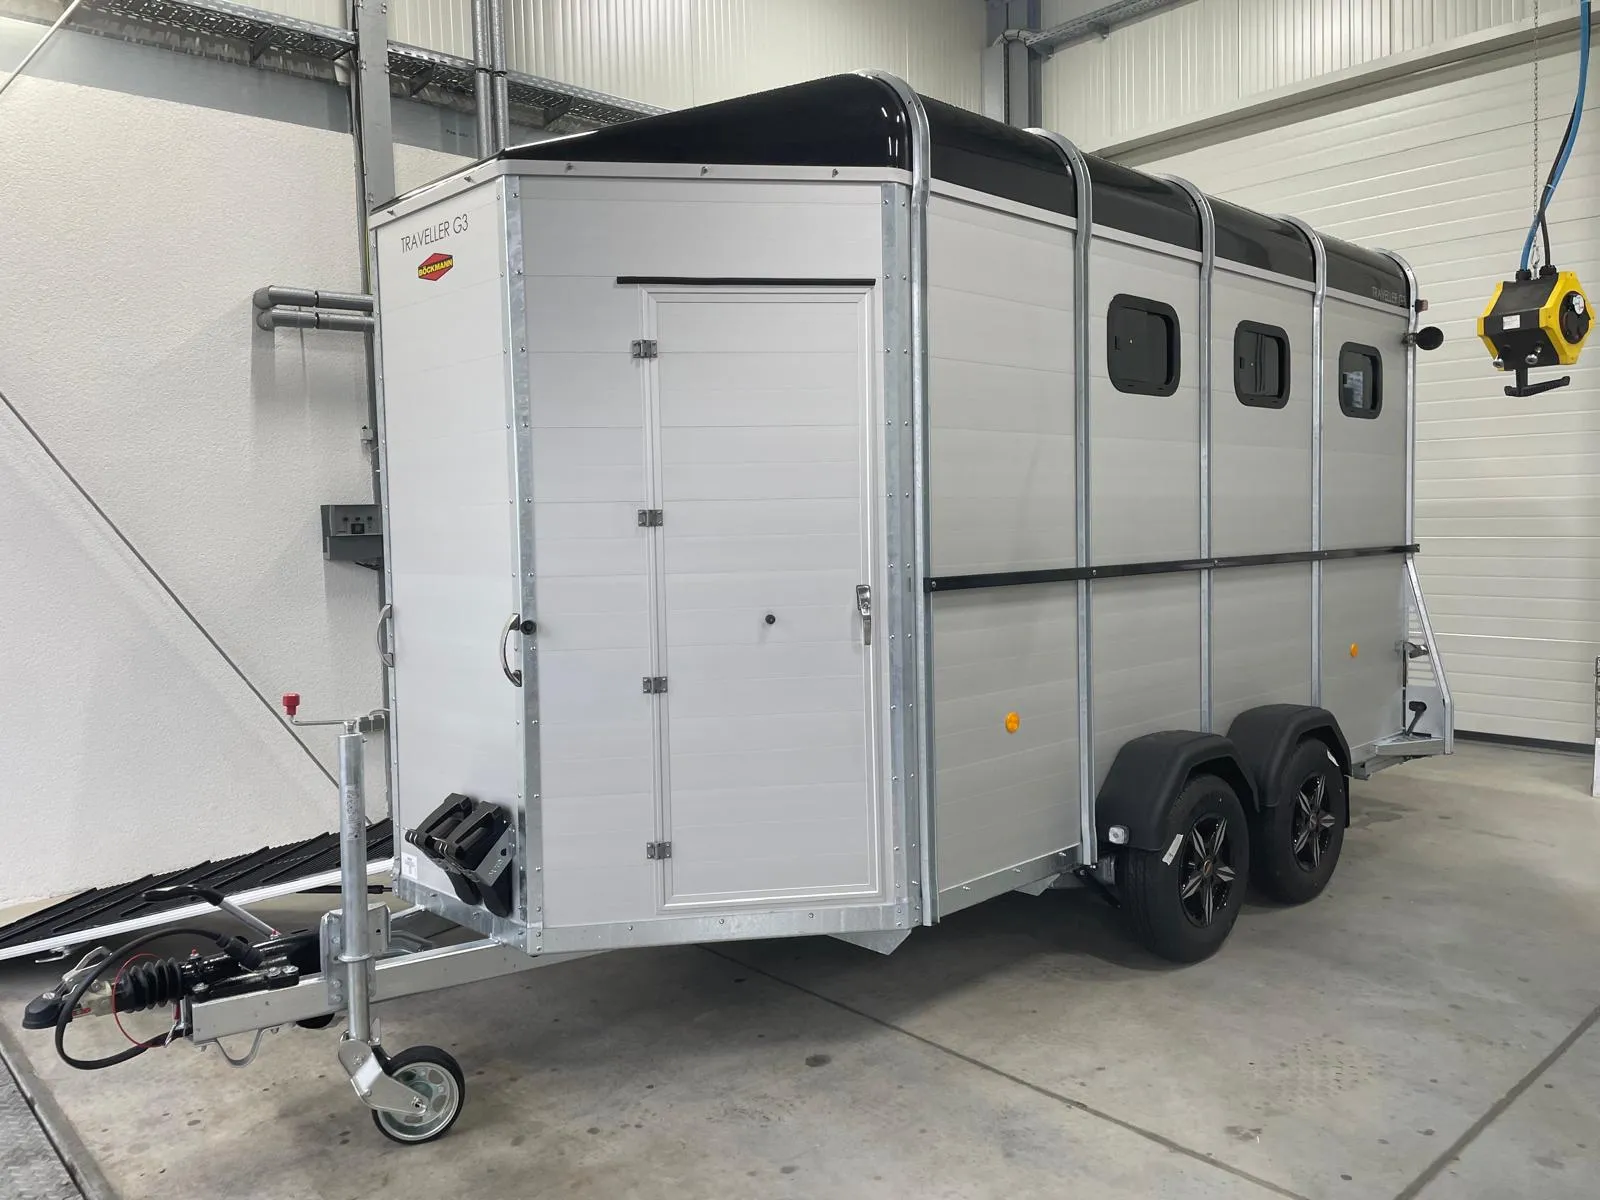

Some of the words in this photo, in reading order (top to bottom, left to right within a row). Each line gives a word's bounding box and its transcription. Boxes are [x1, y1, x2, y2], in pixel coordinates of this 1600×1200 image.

[400, 221, 450, 253] TRAVELLER
[452, 213, 469, 234] G3
[418, 258, 453, 276] BÖCKMANN
